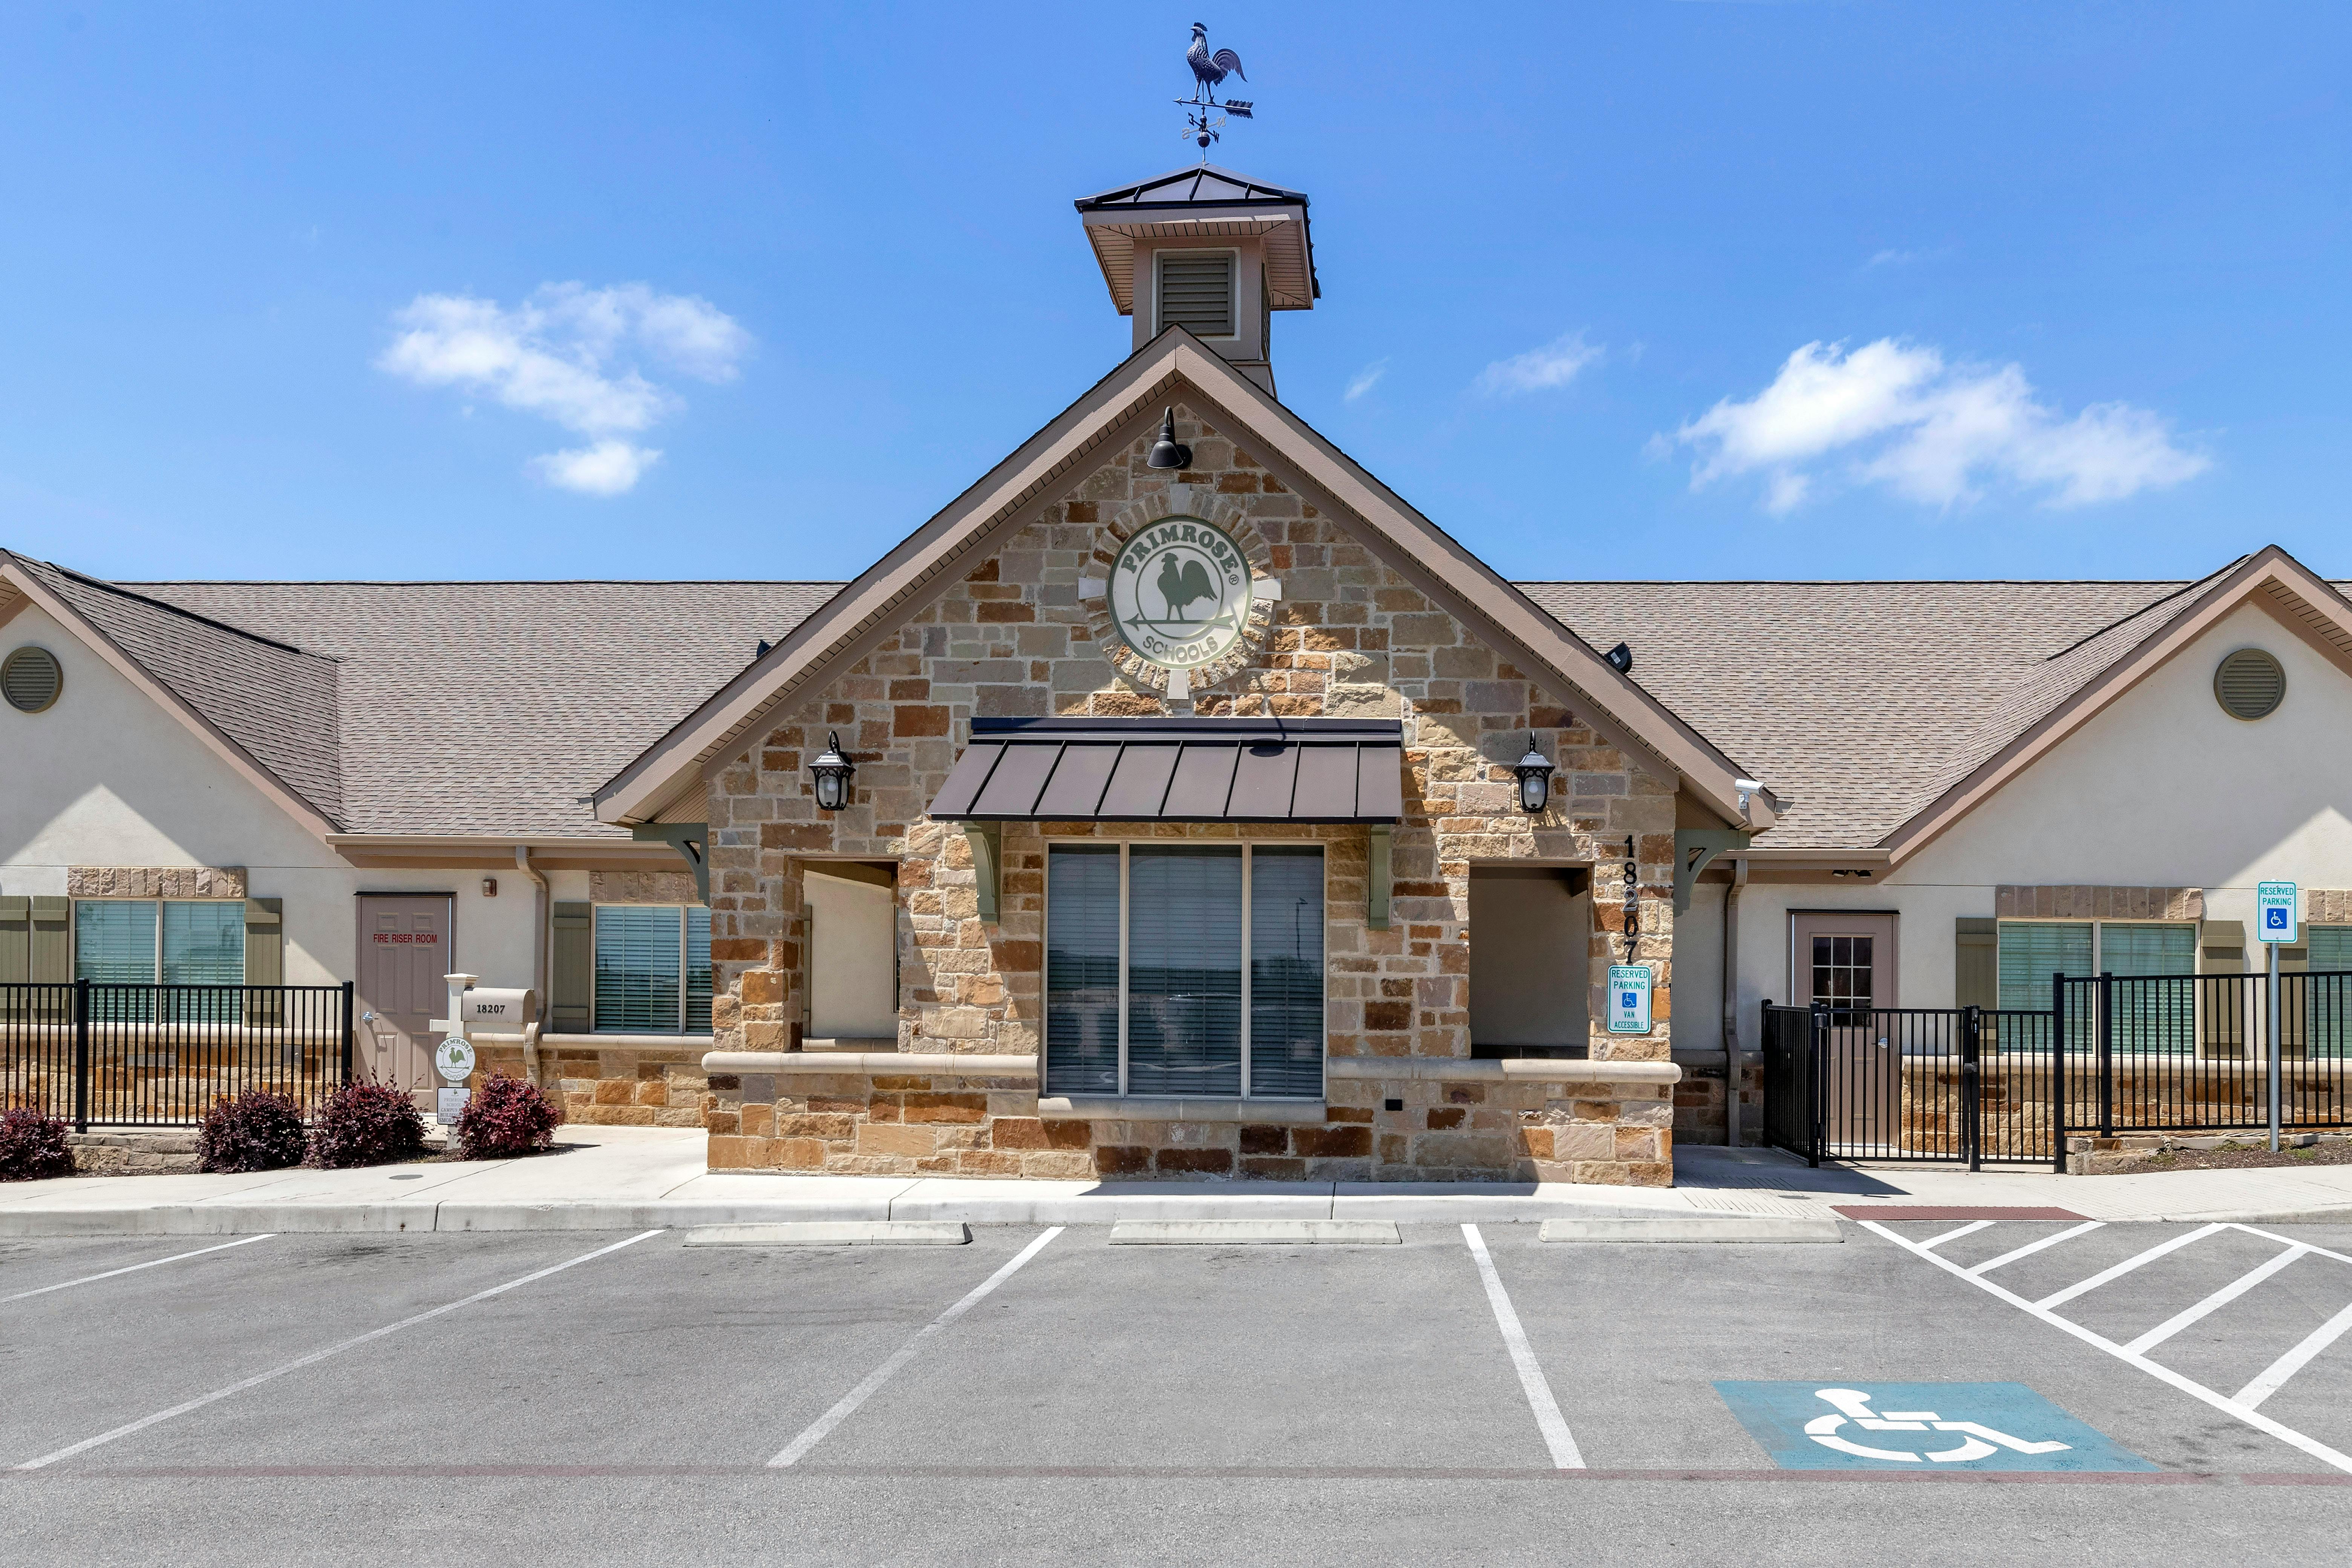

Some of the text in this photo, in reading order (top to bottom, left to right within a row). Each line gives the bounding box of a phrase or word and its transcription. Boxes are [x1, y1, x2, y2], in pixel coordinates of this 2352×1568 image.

[1142, 635, 1219, 663] SCHOOLS
[1623, 835, 1637, 964] 18207
[373, 934, 437, 943] FIRE RISER ROOM
[1611, 970, 1648, 978] RESERVED
[1614, 981, 1645, 989] PARKING
[477, 1004, 505, 1014] 18207
